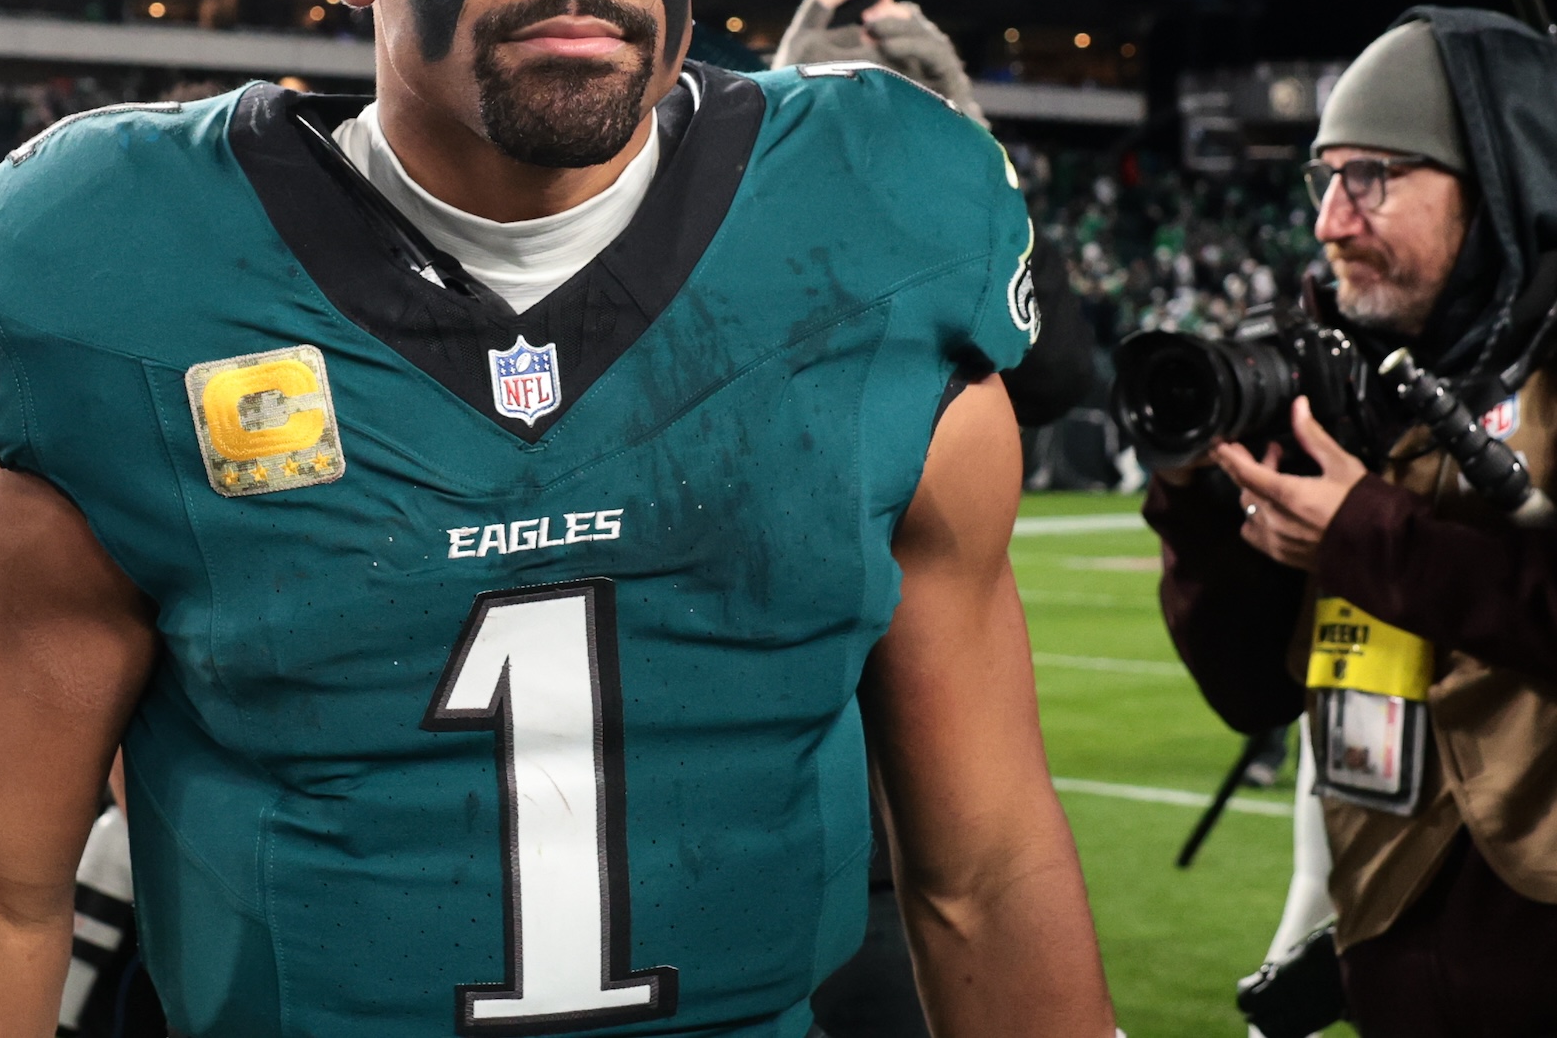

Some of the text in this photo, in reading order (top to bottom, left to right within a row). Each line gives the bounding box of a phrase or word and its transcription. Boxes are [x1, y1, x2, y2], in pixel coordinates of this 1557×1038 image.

[202, 359, 325, 461] C
[502, 375, 550, 409] NFL
[446, 509, 624, 559] EAGLES
[429, 581, 672, 1032] 1
